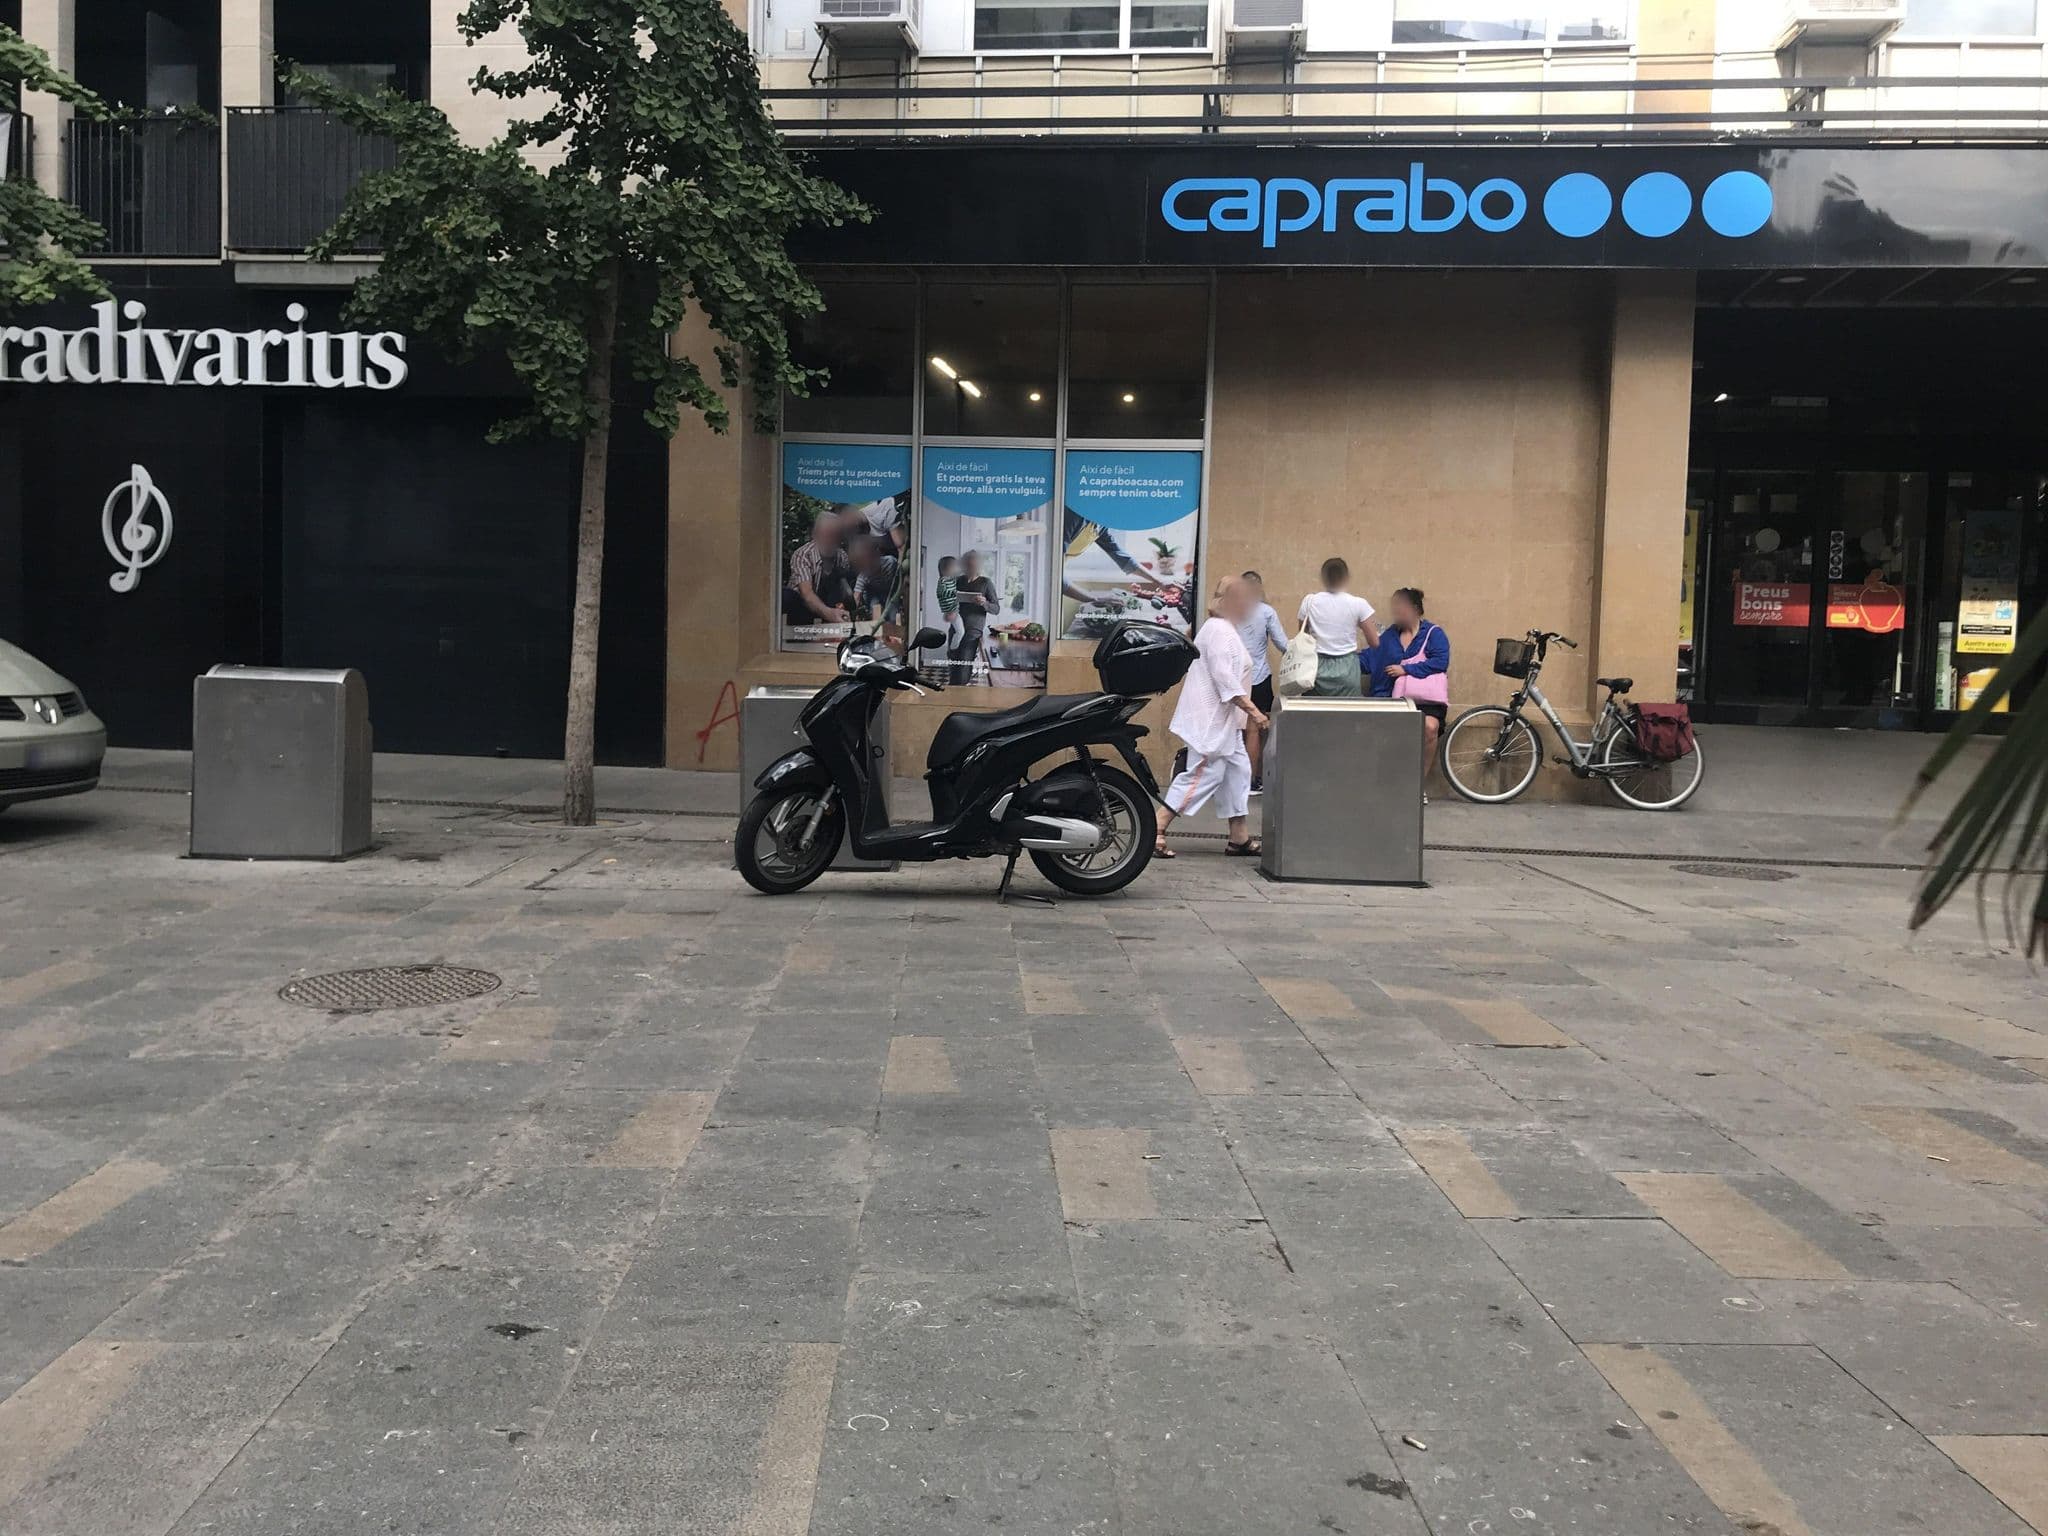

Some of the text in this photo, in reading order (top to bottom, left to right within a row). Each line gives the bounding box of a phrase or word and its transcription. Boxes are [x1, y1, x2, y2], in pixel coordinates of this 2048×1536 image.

[1161, 162, 1527, 248] caprabo
[797, 467, 822, 476] Triem
[823, 469, 838, 479] per
[846, 469, 856, 477] tu
[857, 469, 901, 479] productes
[956, 462, 968, 472] de
[1099, 465, 1112, 475] de
[797, 477, 828, 486] frescos
[833, 478, 845, 486] de
[937, 473, 1046, 485] Et portem gratis la teva
[1079, 476, 1184, 488] A capraboacasa.com
[936, 486, 975, 495] compra,
[995, 487, 1007, 495] on
[1009, 486, 1047, 496] vulguis.
[1079, 488, 1182, 499] sempre tenim obert.
[1742, 584, 1790, 598] Preus
[1741, 597, 1783, 611] bons
[1740, 610, 1783, 624] sempre
